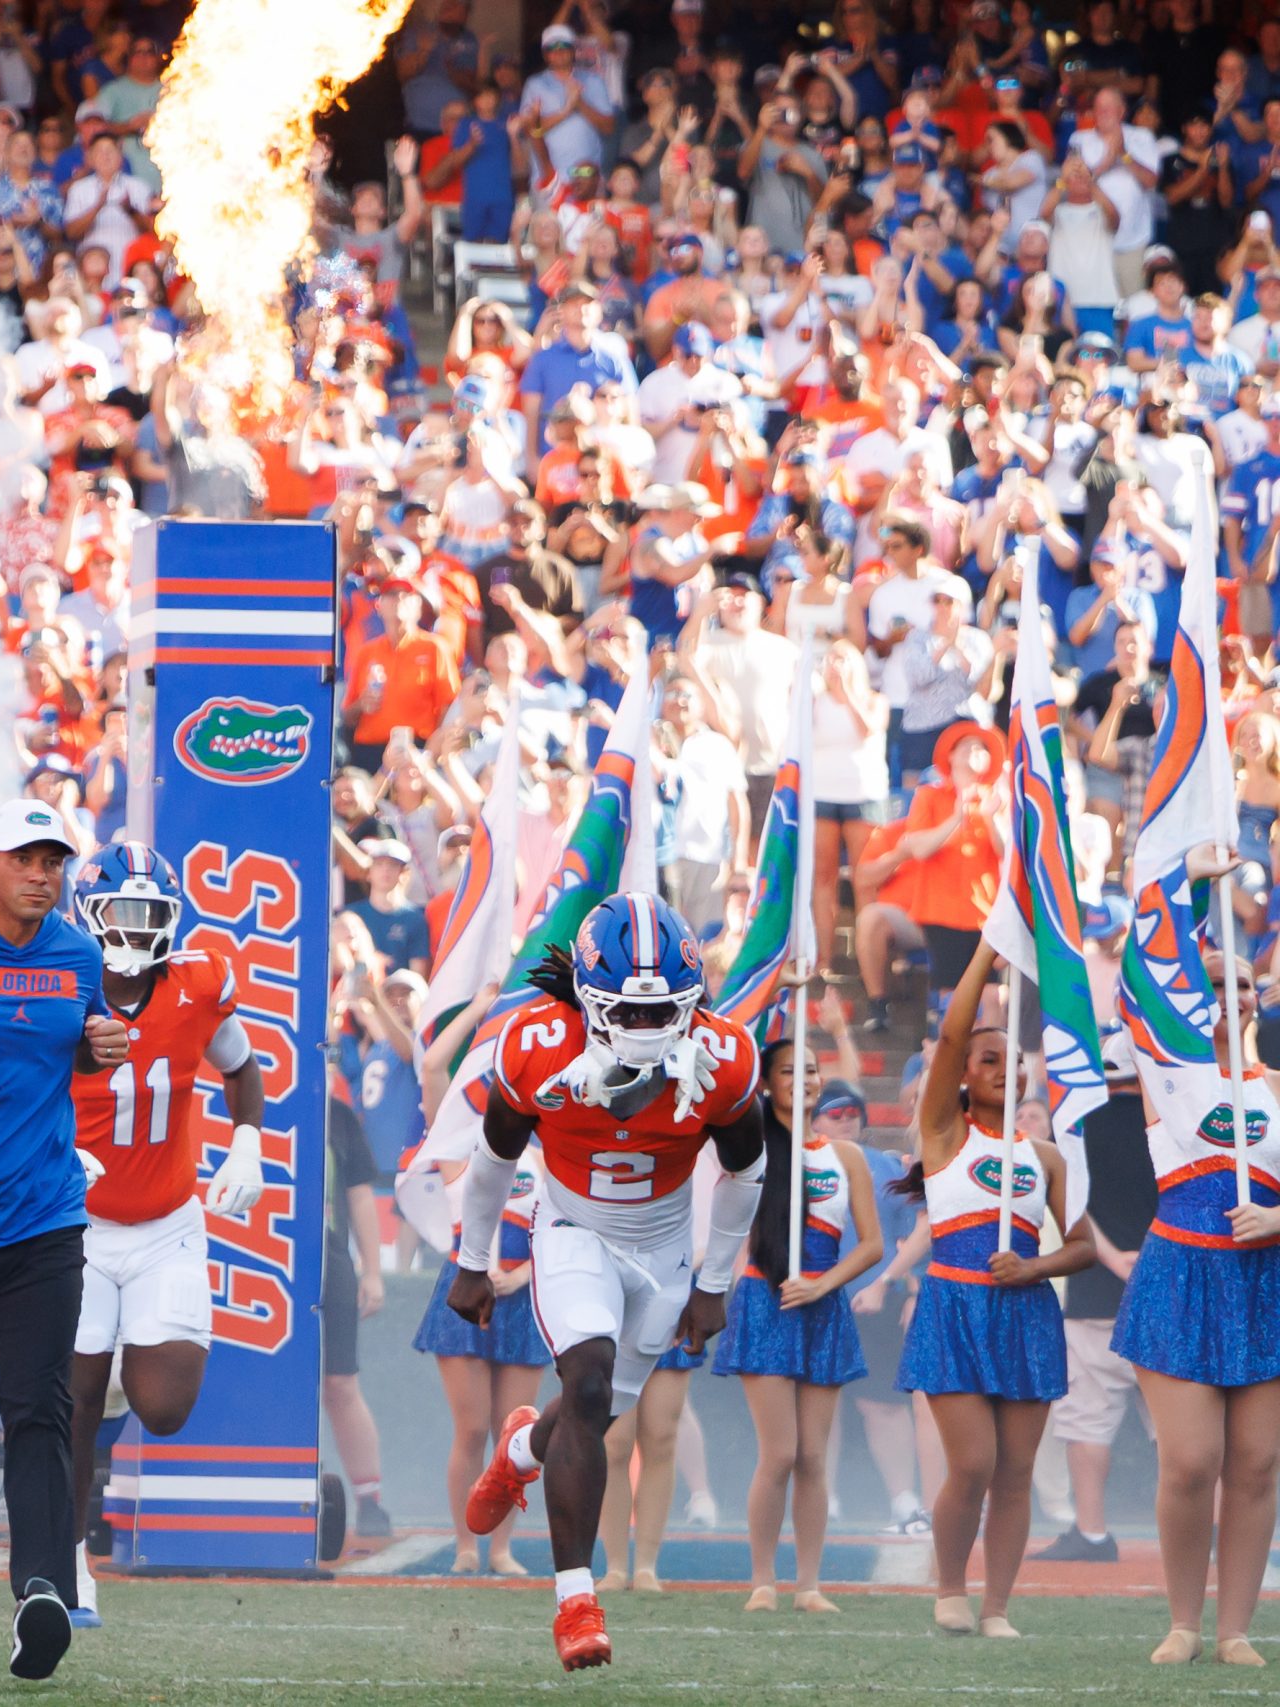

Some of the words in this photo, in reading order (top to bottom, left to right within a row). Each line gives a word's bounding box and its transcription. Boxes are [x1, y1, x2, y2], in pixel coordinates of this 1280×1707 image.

[520, 1018, 567, 1052] 2
[691, 1024, 737, 1062] 2
[108, 1056, 172, 1147] 11
[181, 839, 302, 1355] GATORS
[361, 1059, 389, 1109] 6
[588, 1150, 657, 1201] 2
